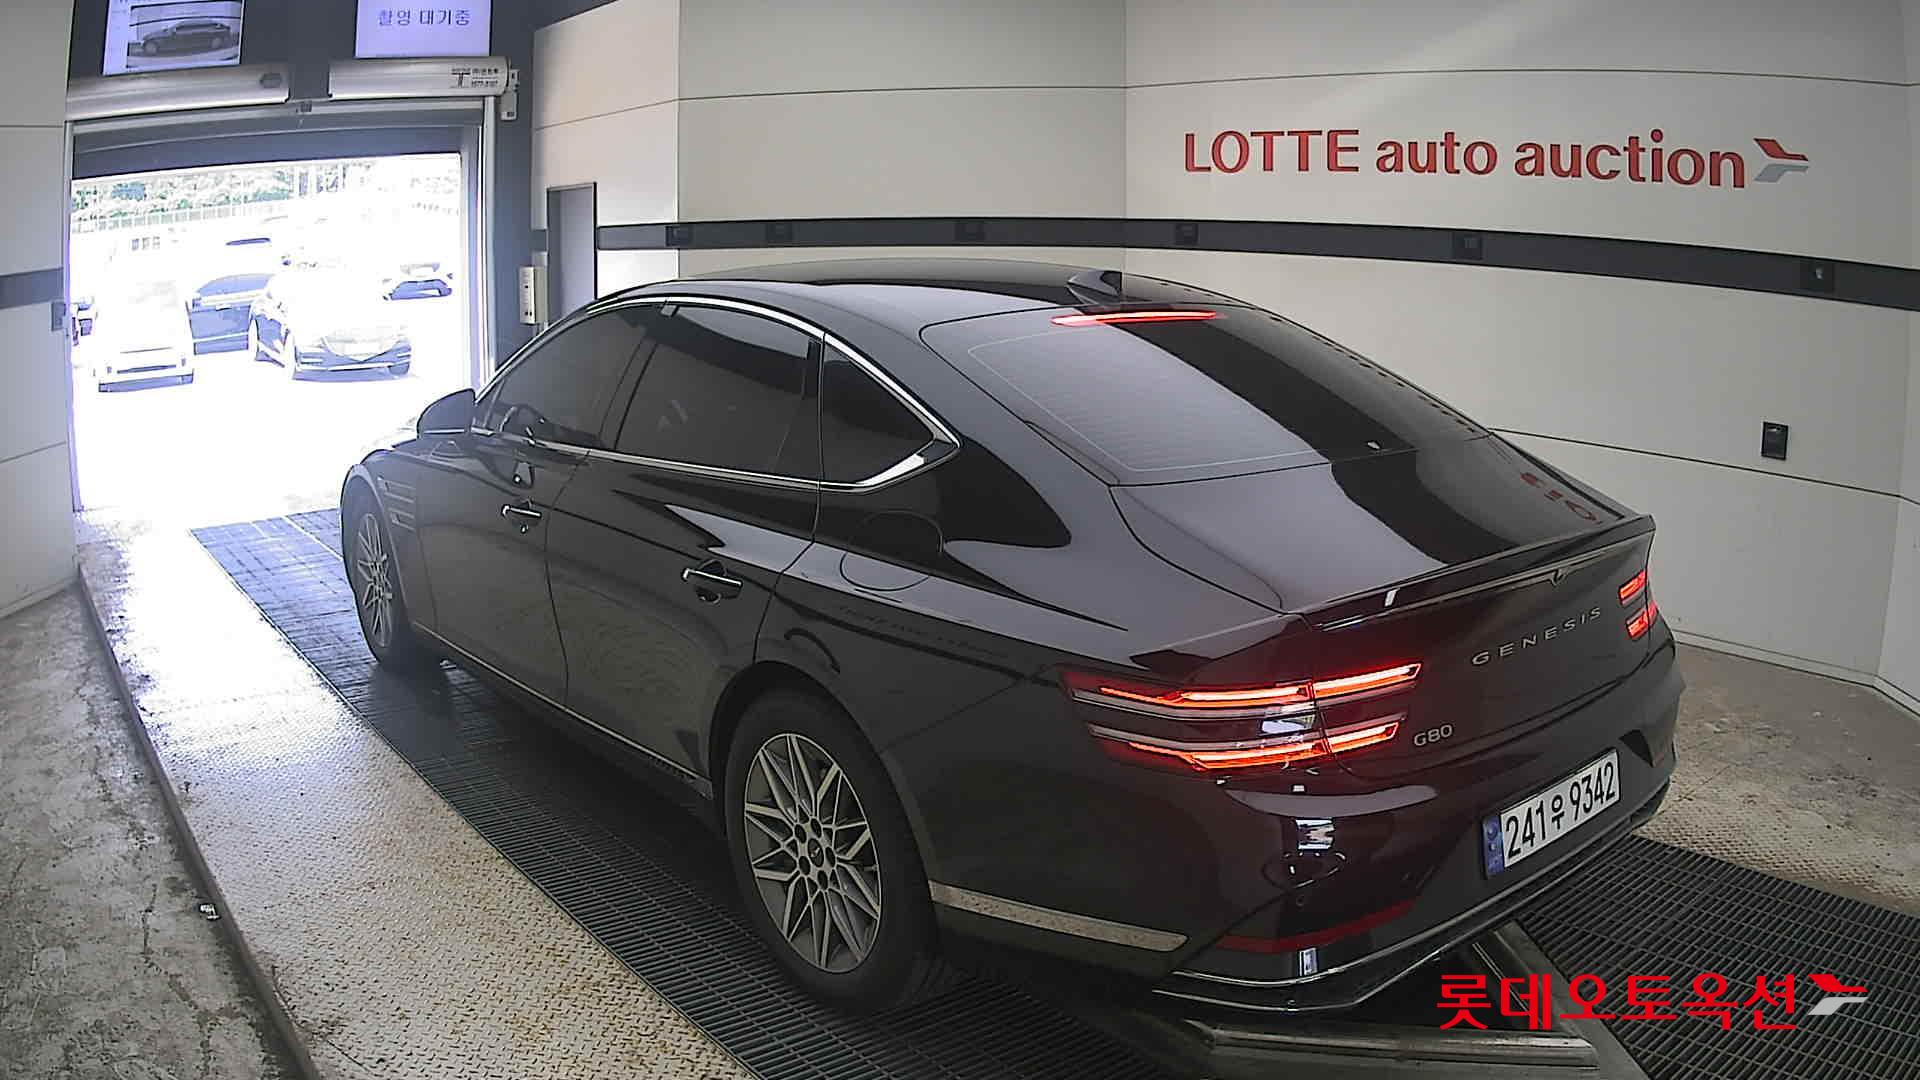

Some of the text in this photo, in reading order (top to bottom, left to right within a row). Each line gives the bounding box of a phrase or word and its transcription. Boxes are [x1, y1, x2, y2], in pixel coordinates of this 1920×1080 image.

[419, 9, 470, 26] 대기중
[1184, 129, 1745, 188] LOTTE auto auction
[1472, 607, 1601, 665] GENESIS
[1413, 724, 1453, 746] G80
[1505, 760, 1616, 859] 241우 9342
